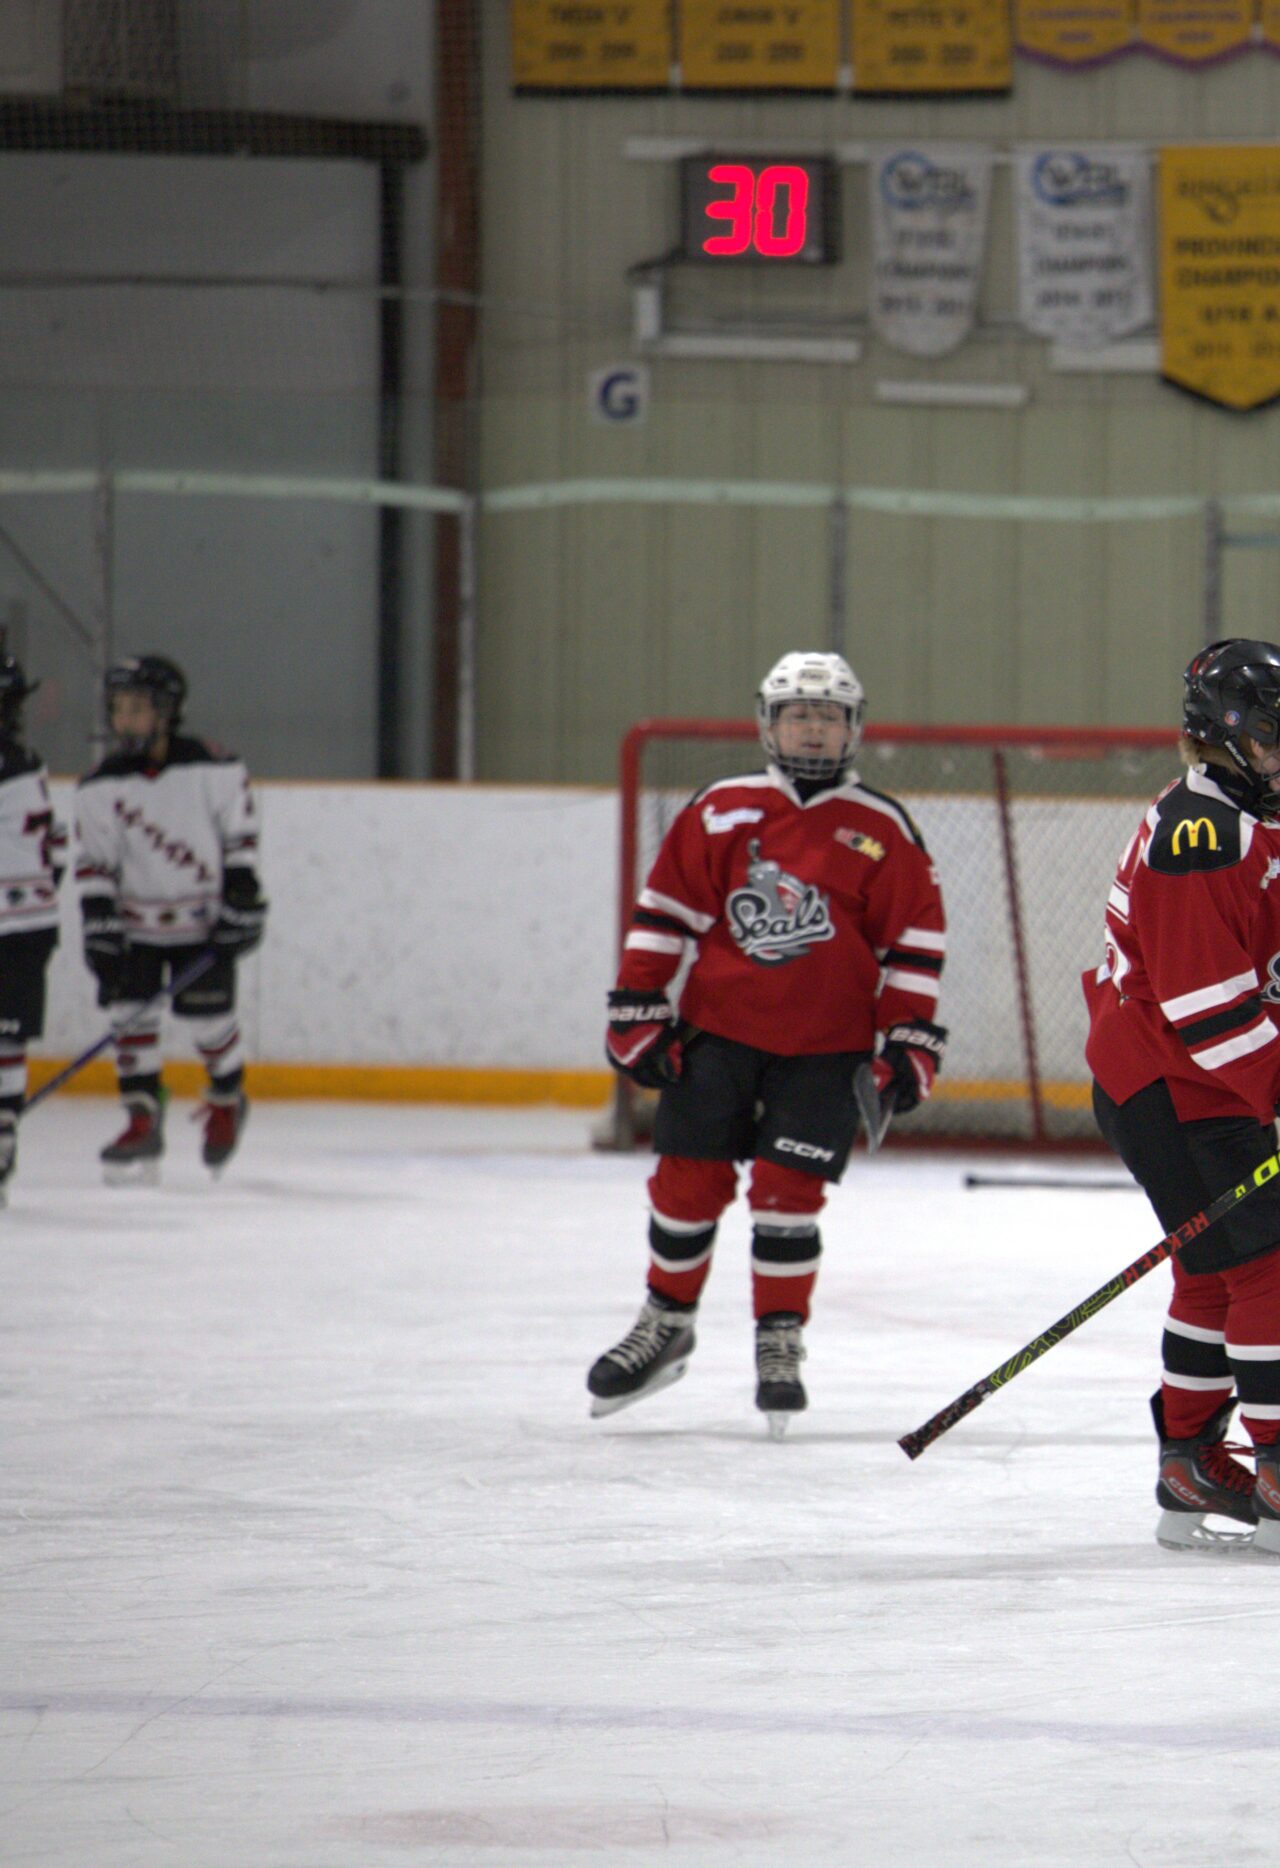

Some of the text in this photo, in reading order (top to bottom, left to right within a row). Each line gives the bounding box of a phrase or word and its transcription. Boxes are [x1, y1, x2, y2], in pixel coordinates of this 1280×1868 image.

[703, 165, 810, 257] 30
[599, 371, 638, 420] G
[727, 884, 835, 944] Seals
[774, 1136, 836, 1163] CCM
[1121, 1210, 1211, 1287] REKKER
[1168, 1476, 1208, 1507] CCM
